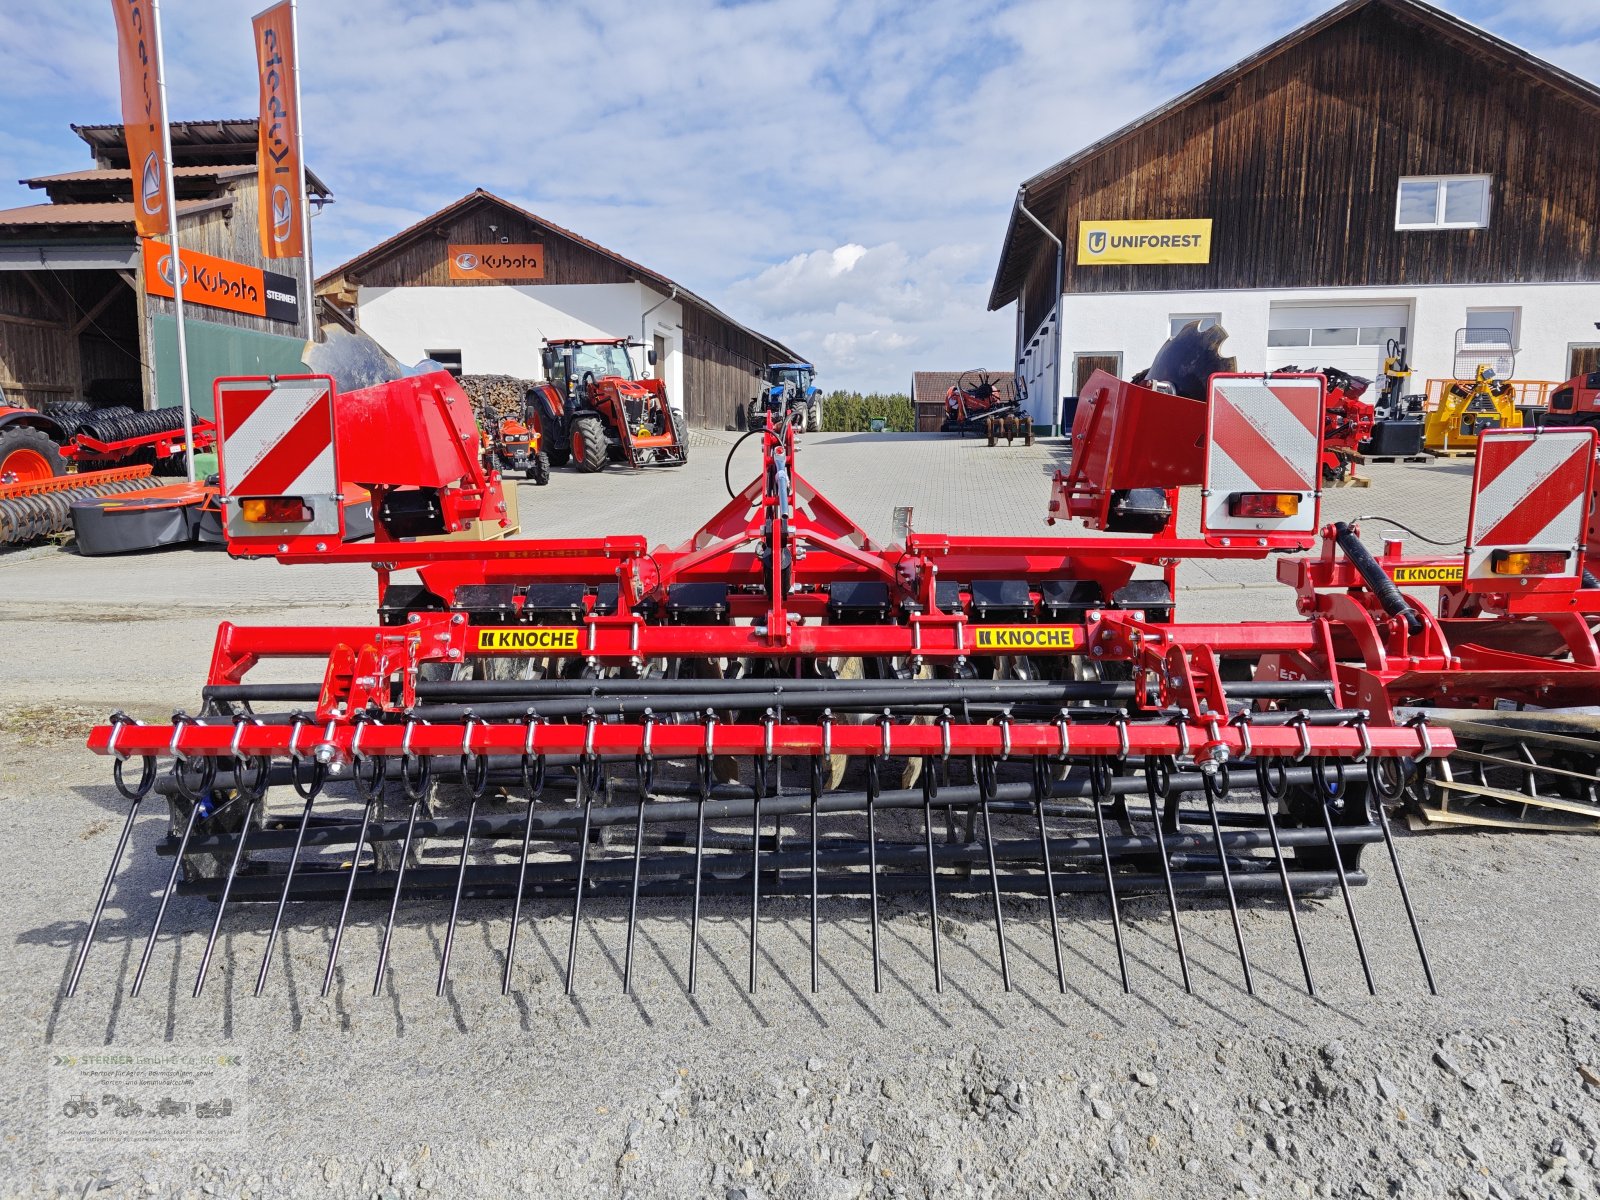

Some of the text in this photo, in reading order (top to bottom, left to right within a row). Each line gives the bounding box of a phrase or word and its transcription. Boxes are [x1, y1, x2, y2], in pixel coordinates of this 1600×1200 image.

[1110, 234, 1202, 248] UNIFOREST
[481, 254, 537, 269] Kubota
[193, 265, 258, 302] Kubota
[266, 290, 297, 304] STERNER
[1408, 568, 1464, 580] KNOCHE
[498, 632, 575, 647] KNOCHE
[996, 630, 1071, 646] KNOCHE
